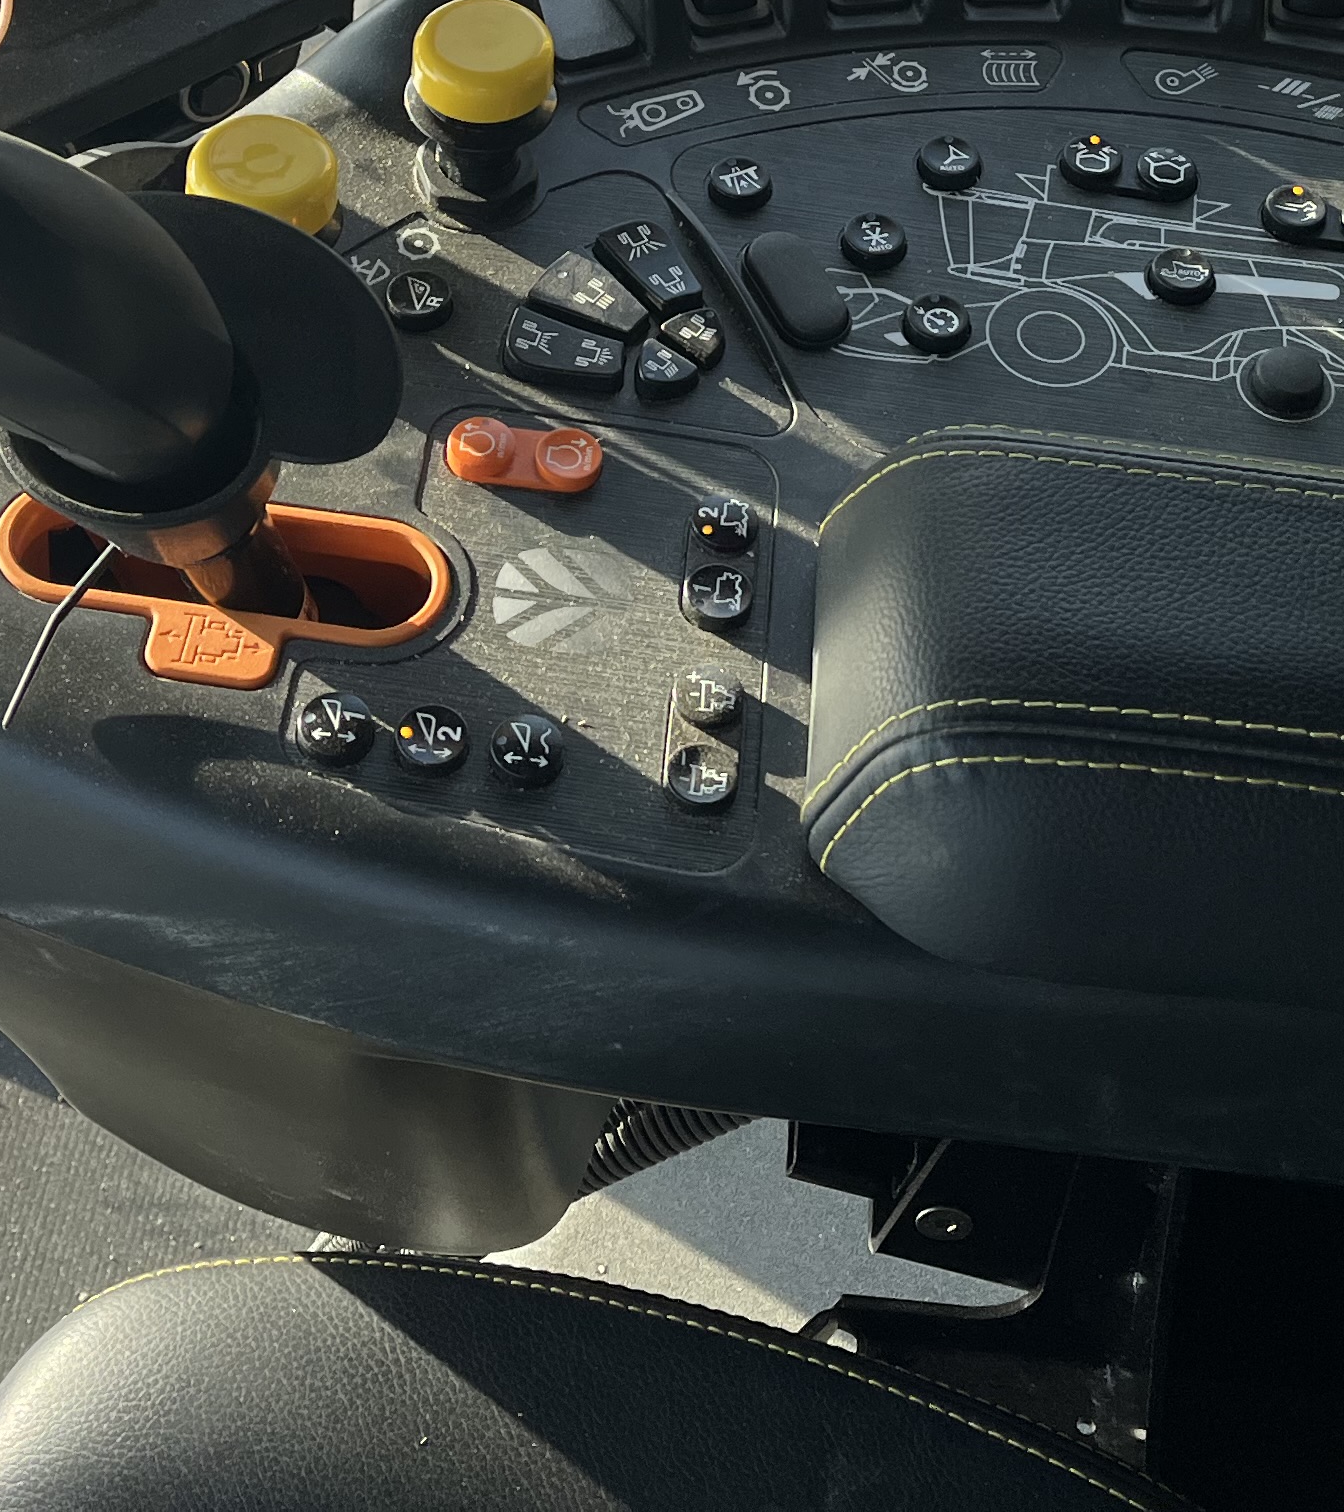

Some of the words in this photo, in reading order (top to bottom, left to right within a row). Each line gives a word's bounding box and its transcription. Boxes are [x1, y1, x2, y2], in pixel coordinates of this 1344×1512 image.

[868, 243, 893, 252] AUTO
[1177, 268, 1201, 277] AUTO
[426, 296, 444, 308] R
[698, 506, 719, 519] 2
[342, 709, 366, 722] 1
[437, 725, 462, 742] 2
